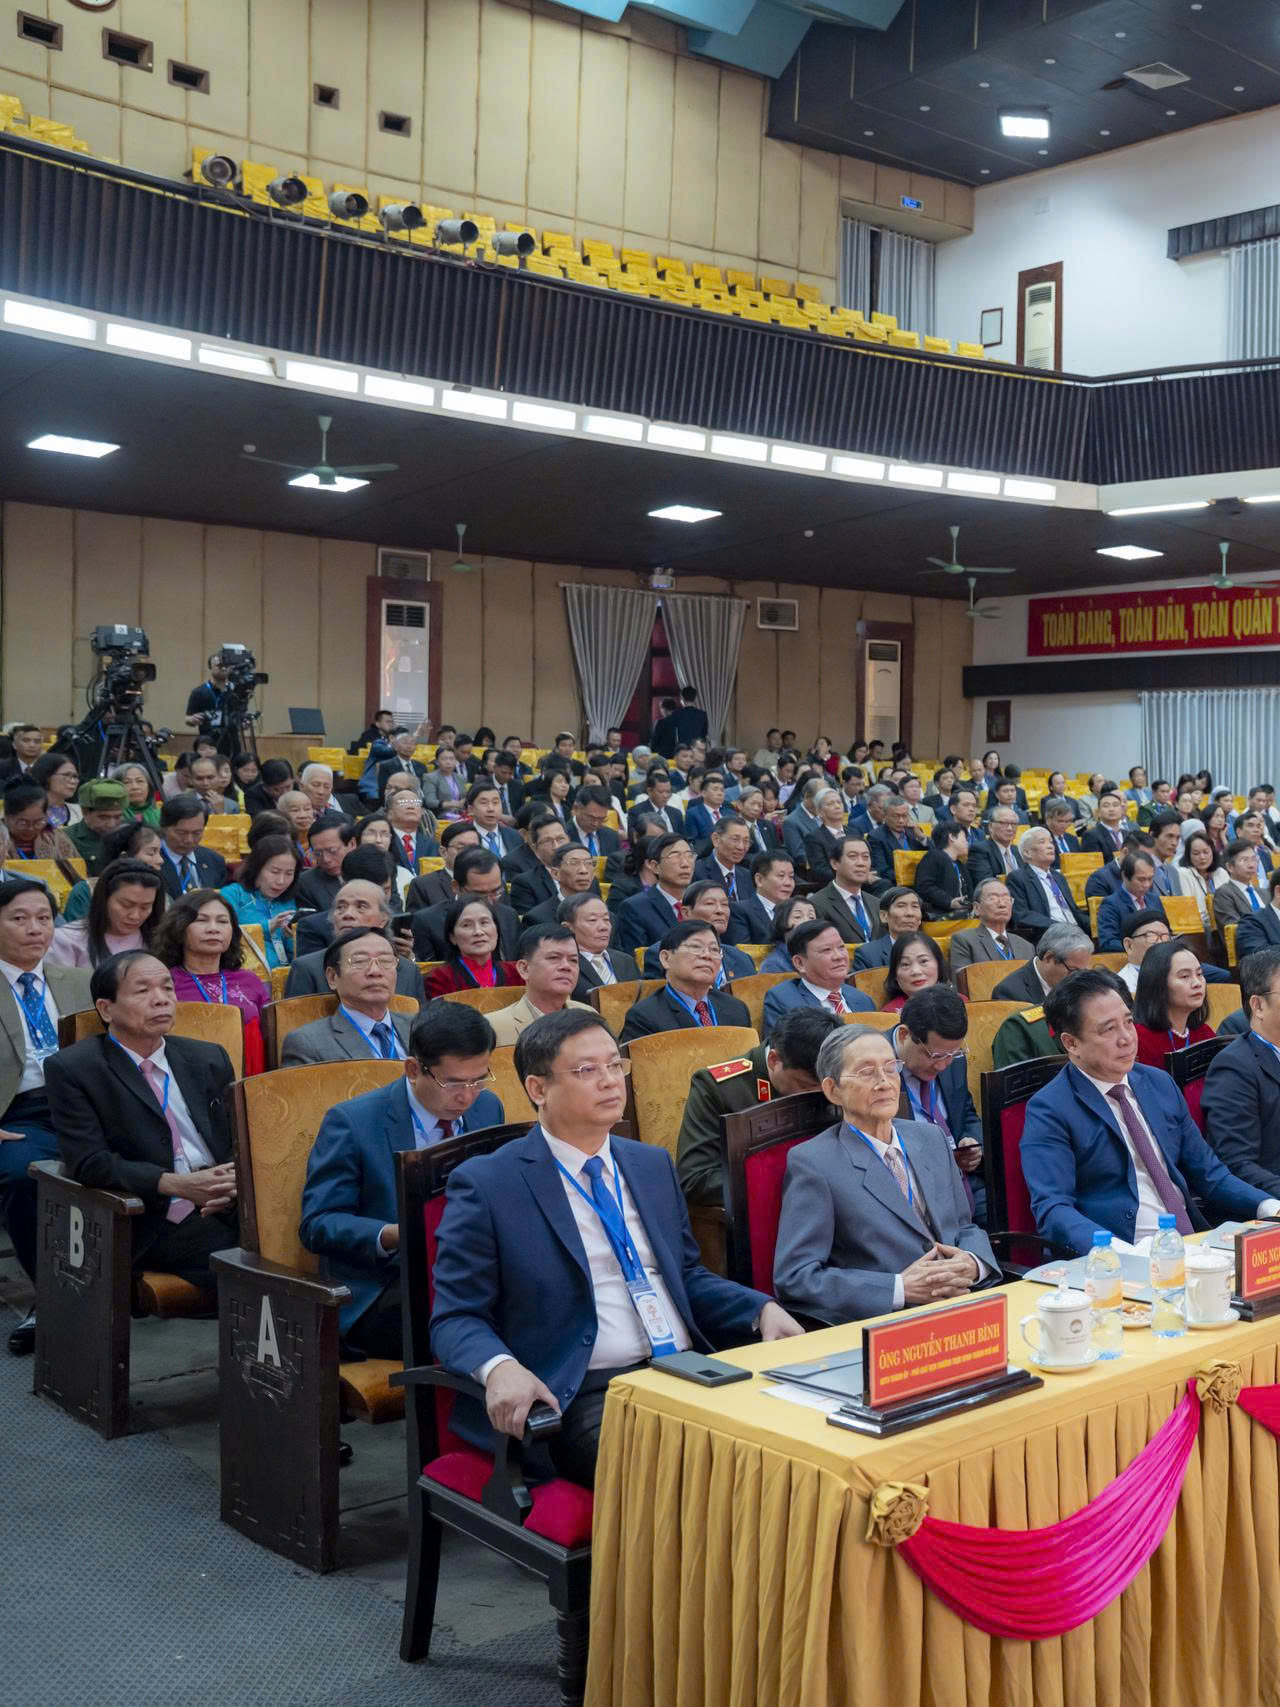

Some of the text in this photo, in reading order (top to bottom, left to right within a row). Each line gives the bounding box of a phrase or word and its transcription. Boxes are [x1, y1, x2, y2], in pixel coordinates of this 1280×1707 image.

[1043, 602, 1075, 647] TOÀN
[1119, 596, 1153, 643] TOÀN
[1156, 595, 1189, 644] DÂN,
[1192, 591, 1229, 639] TOÀN
[1232, 589, 1273, 640] QUÂN
[69, 1206, 85, 1268] B
[256, 1295, 282, 1367] A
[879, 1349, 901, 1371] ÔNG
[902, 1332, 942, 1364] NGUYỄN
[944, 1330, 977, 1354] THANH
[977, 1321, 1001, 1345] BÌNH
